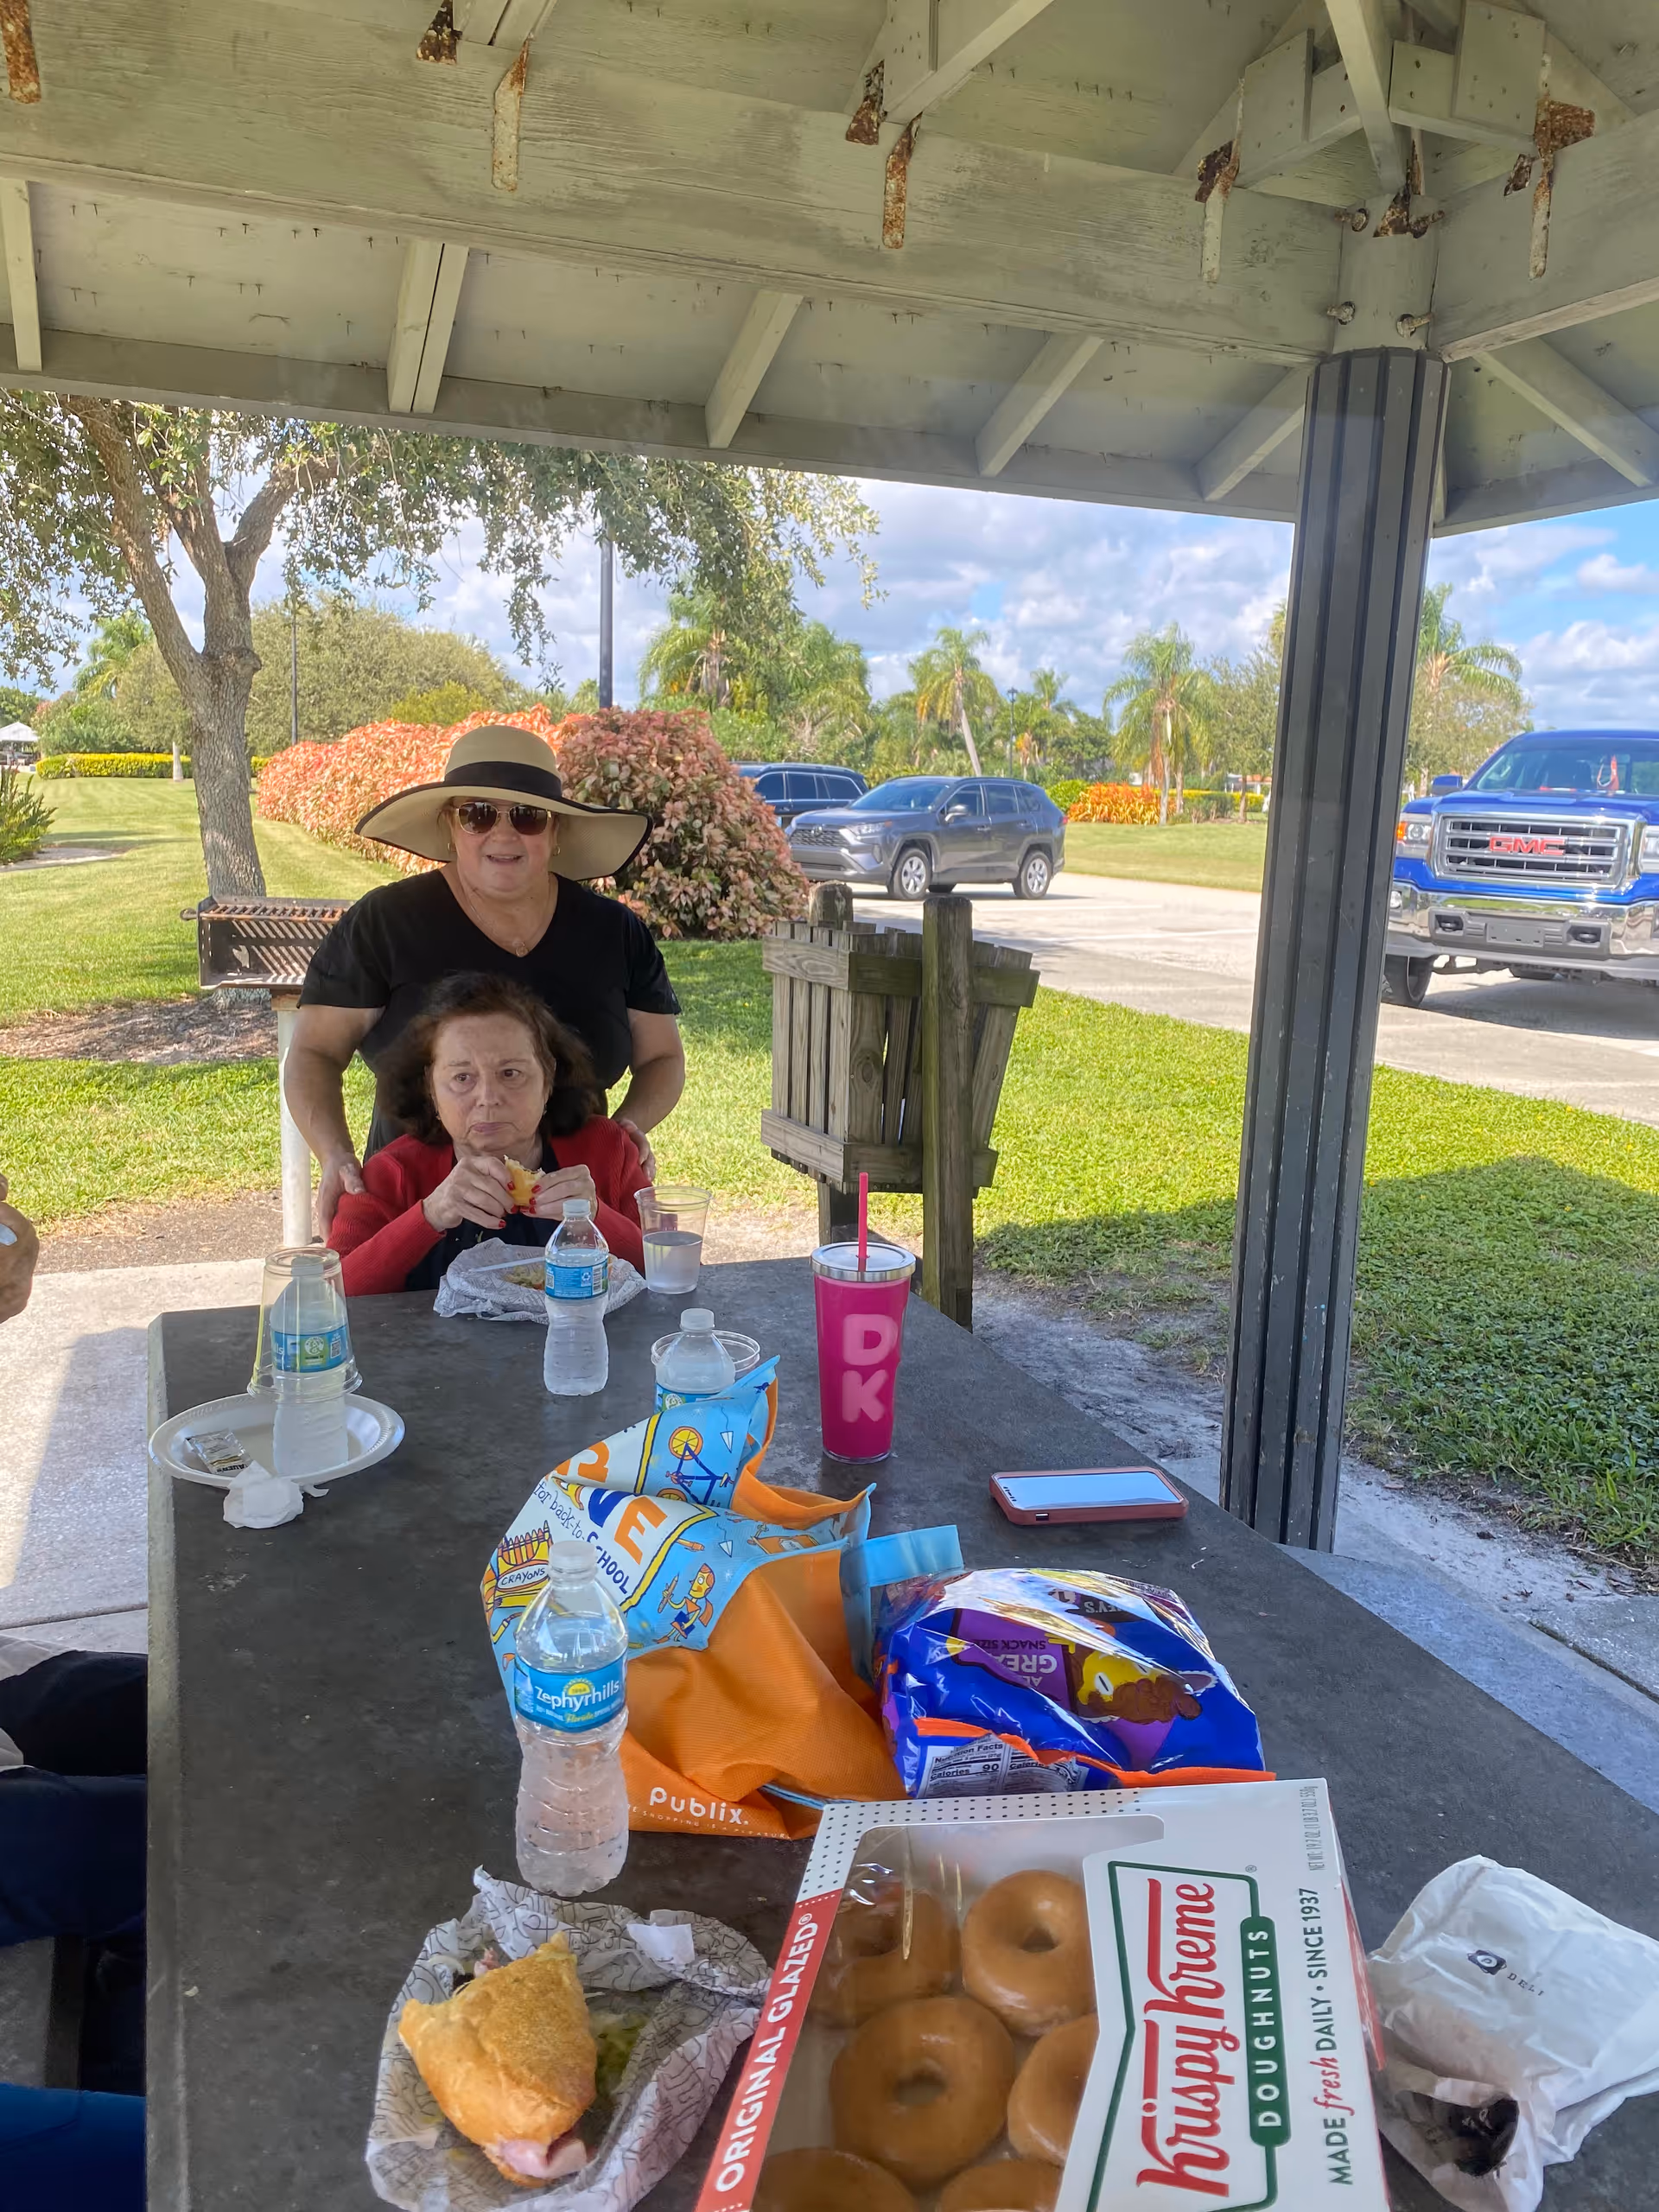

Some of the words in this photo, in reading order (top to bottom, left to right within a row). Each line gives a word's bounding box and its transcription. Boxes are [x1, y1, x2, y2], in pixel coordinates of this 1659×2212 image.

[1489, 836, 1565, 855] GMC
[533, 1481, 551, 1504] for
[1001, 1639, 1046, 1649] SNACK
[535, 1680, 620, 1712] Zephyrhills
[976, 1743, 1003, 1754] Facts
[931, 1767, 970, 1780] Calories
[982, 1764, 999, 1772] 90
[1308, 1861, 1326, 1871] NET
[1299, 1887, 1323, 1923] 1937
[1143, 1878, 1226, 2021] Kreme
[1303, 1925, 1328, 1979] SINCE
[1507, 1973, 1544, 1996] DELI
[1248, 1930, 1281, 2127] DOUGHNUTS
[1310, 1997, 1338, 2052] DAILY
[1309, 2056, 1356, 2117] fresh
[715, 2026, 787, 2192] ORIGINAL
[1136, 2019, 1240, 2198] Krispy
[1328, 2117, 1354, 2186] MADE
